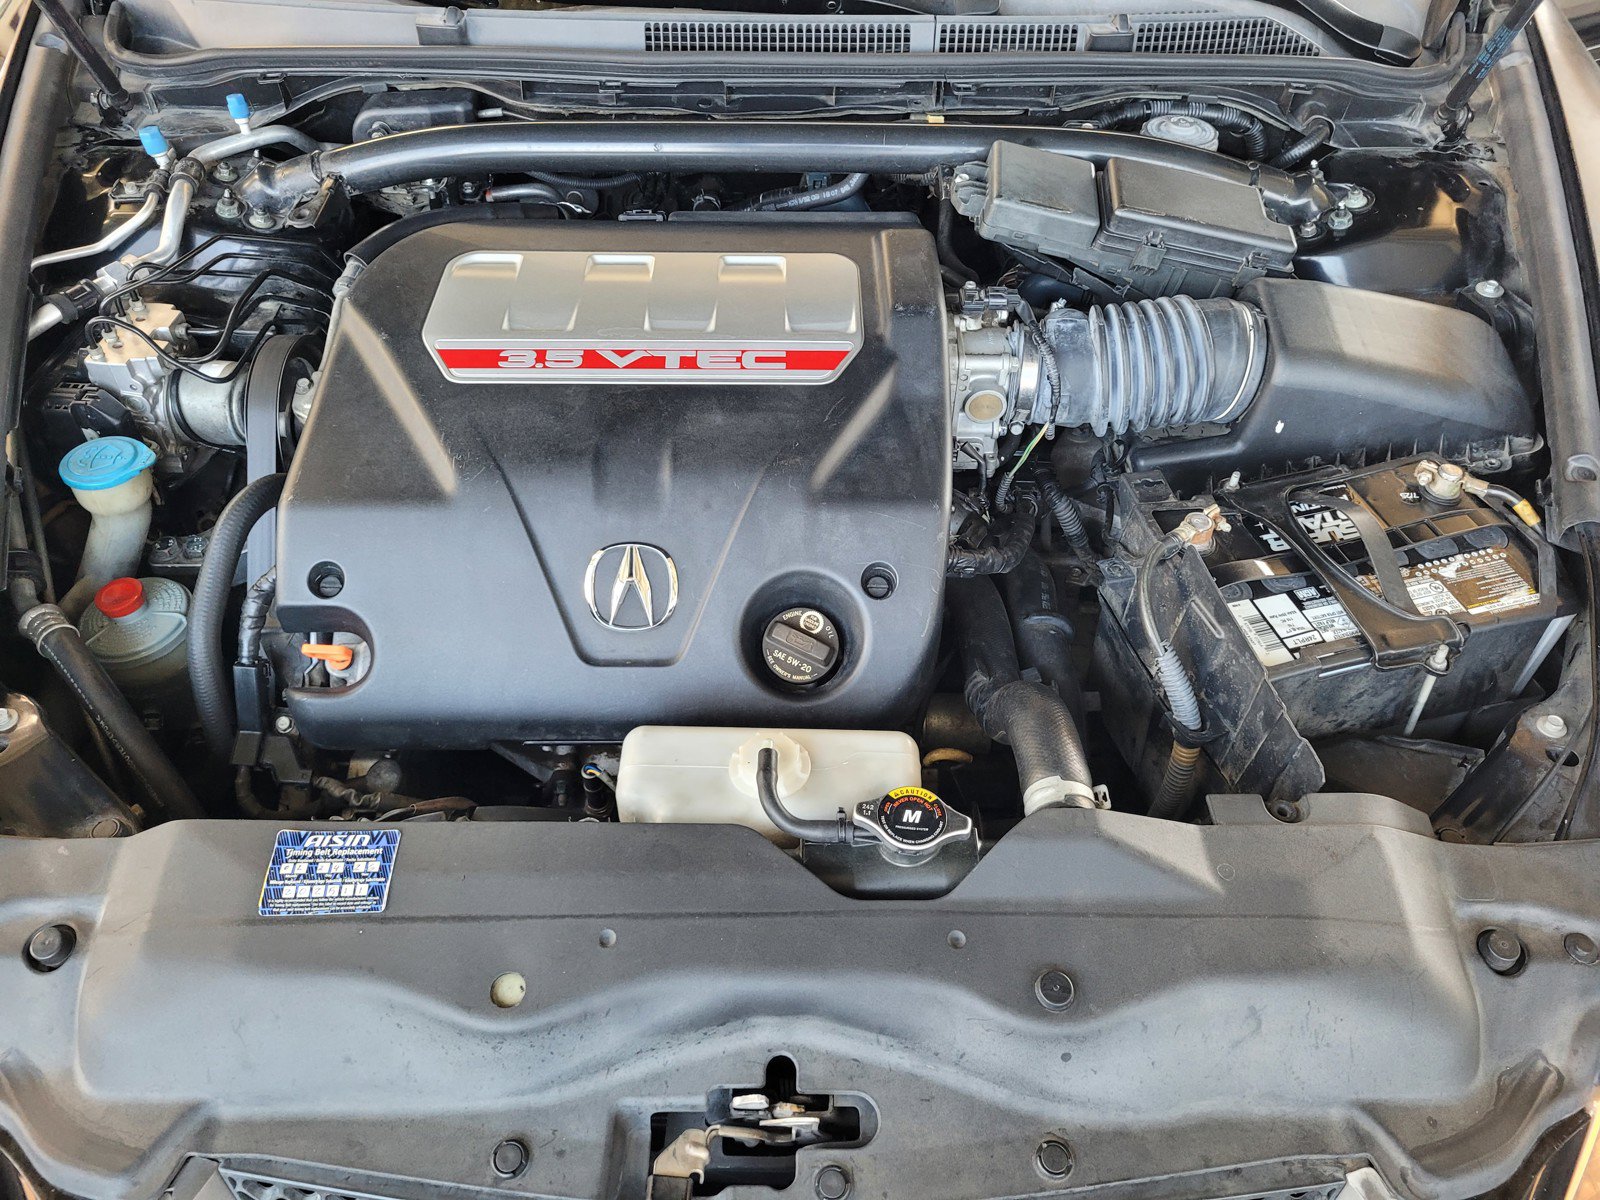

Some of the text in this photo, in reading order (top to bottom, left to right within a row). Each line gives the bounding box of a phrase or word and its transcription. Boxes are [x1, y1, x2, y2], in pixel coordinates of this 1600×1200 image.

[498, 349, 787, 369] 3.5 VTEC
[1296, 587, 1318, 599] AGM
[782, 610, 834, 638] ENGINE OIL
[1292, 634, 1317, 645] 24RPLT
[773, 649, 812, 673] SAE 5W-20
[900, 789, 933, 800] CAUTION
[893, 797, 909, 807] NEVER
[924, 801, 933, 811] HOT
[902, 809, 922, 823] M
[303, 834, 371, 847] AISIN
[285, 847, 383, 858] Timing Belt Replacement
